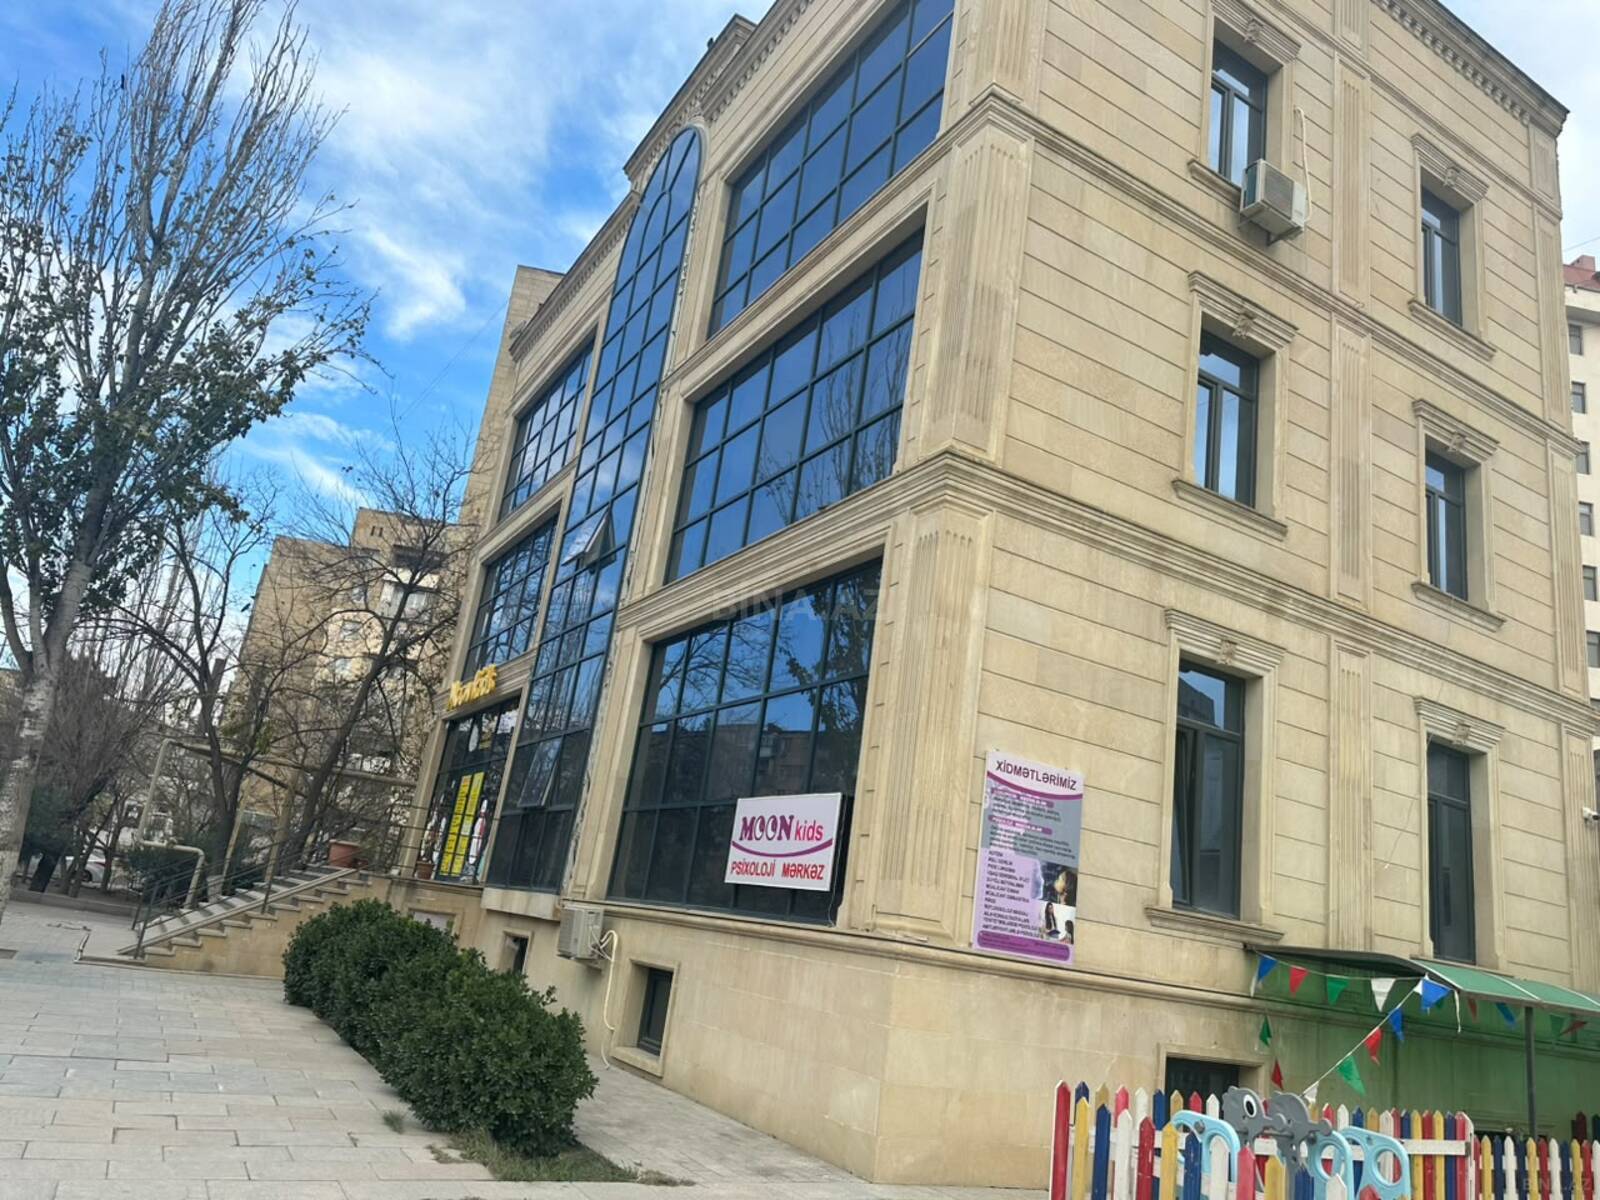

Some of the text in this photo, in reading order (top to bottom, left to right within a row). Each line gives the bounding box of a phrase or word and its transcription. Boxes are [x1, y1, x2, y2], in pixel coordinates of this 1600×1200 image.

[996, 760, 1077, 790] XİDMƏTLƏRİMİZ
[740, 815, 824, 841] MOON kids
[781, 862, 825, 880] MƏRKƏZ
